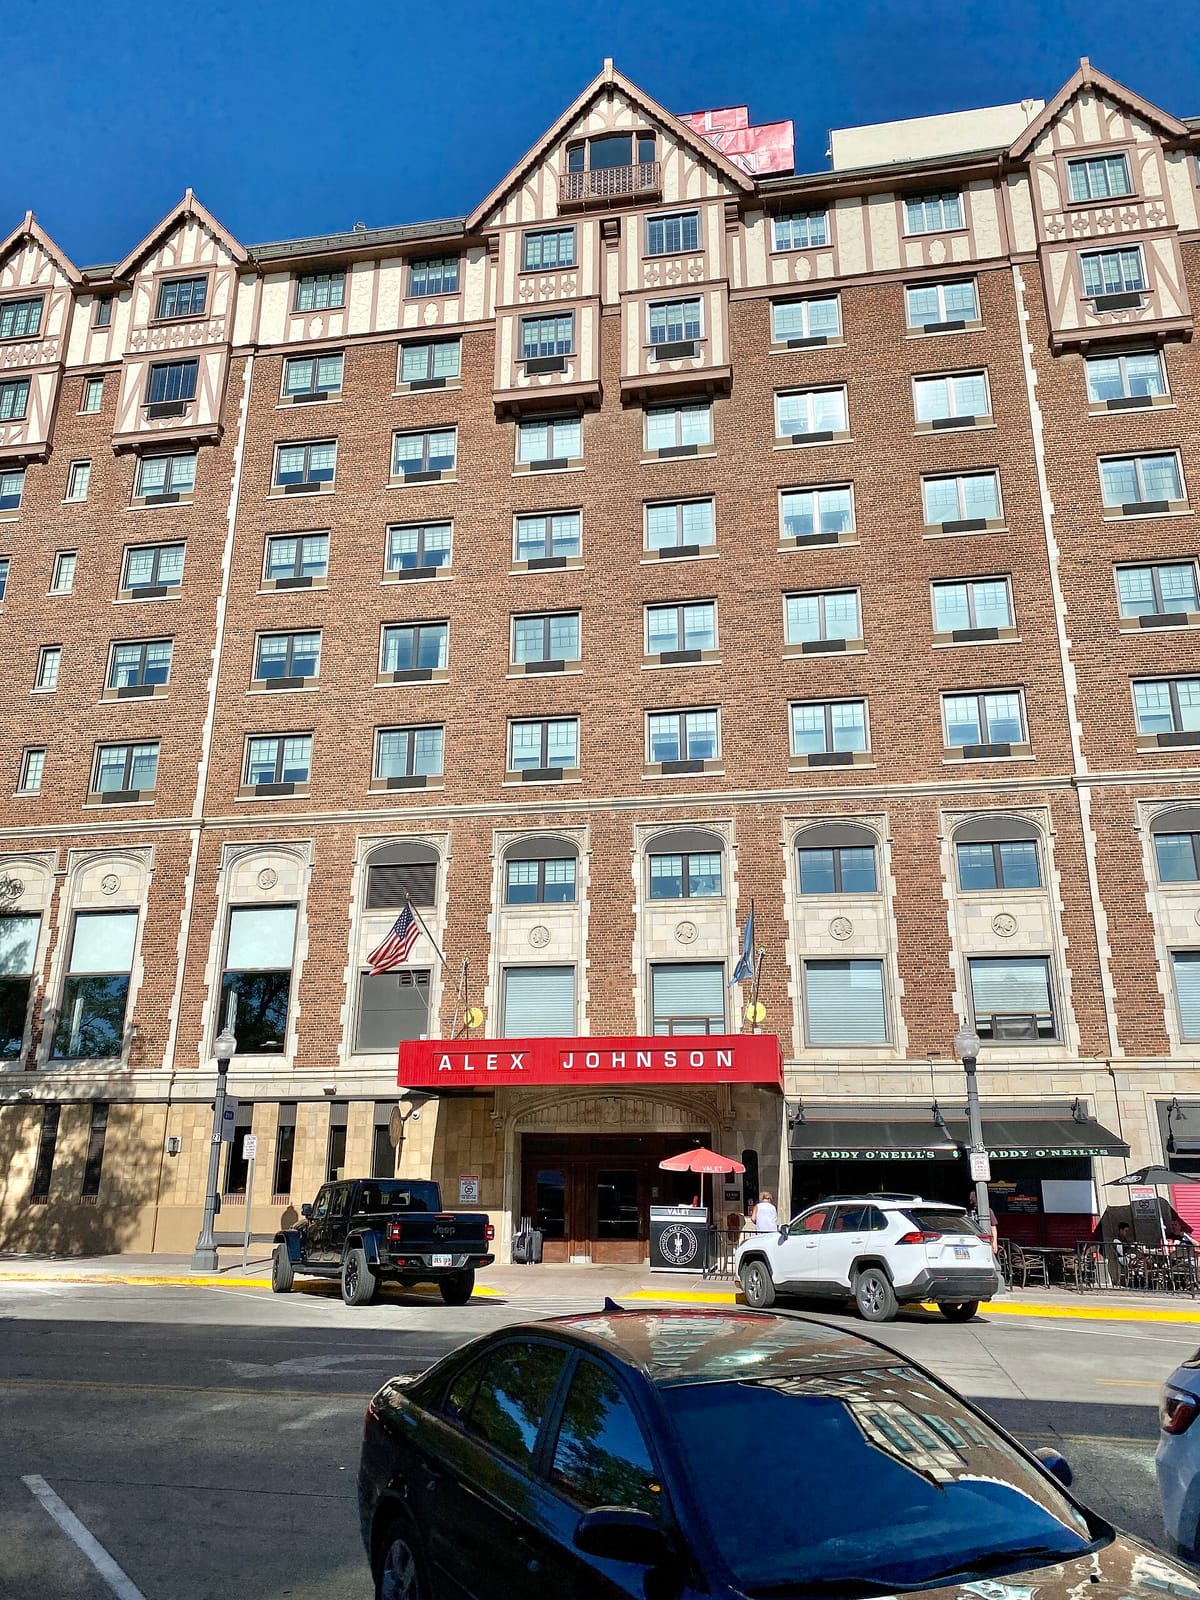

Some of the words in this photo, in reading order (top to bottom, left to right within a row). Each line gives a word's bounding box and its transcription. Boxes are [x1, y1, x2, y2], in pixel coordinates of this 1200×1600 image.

[437, 1053, 525, 1072] ALEX
[562, 1050, 734, 1069] JOHNSON
[812, 1151, 859, 1159] PADDY
[865, 1150, 935, 1159] O'NEILL'S
[1035, 1148, 1109, 1157] O'NEILL'S
[432, 1225, 456, 1236] Jeep
